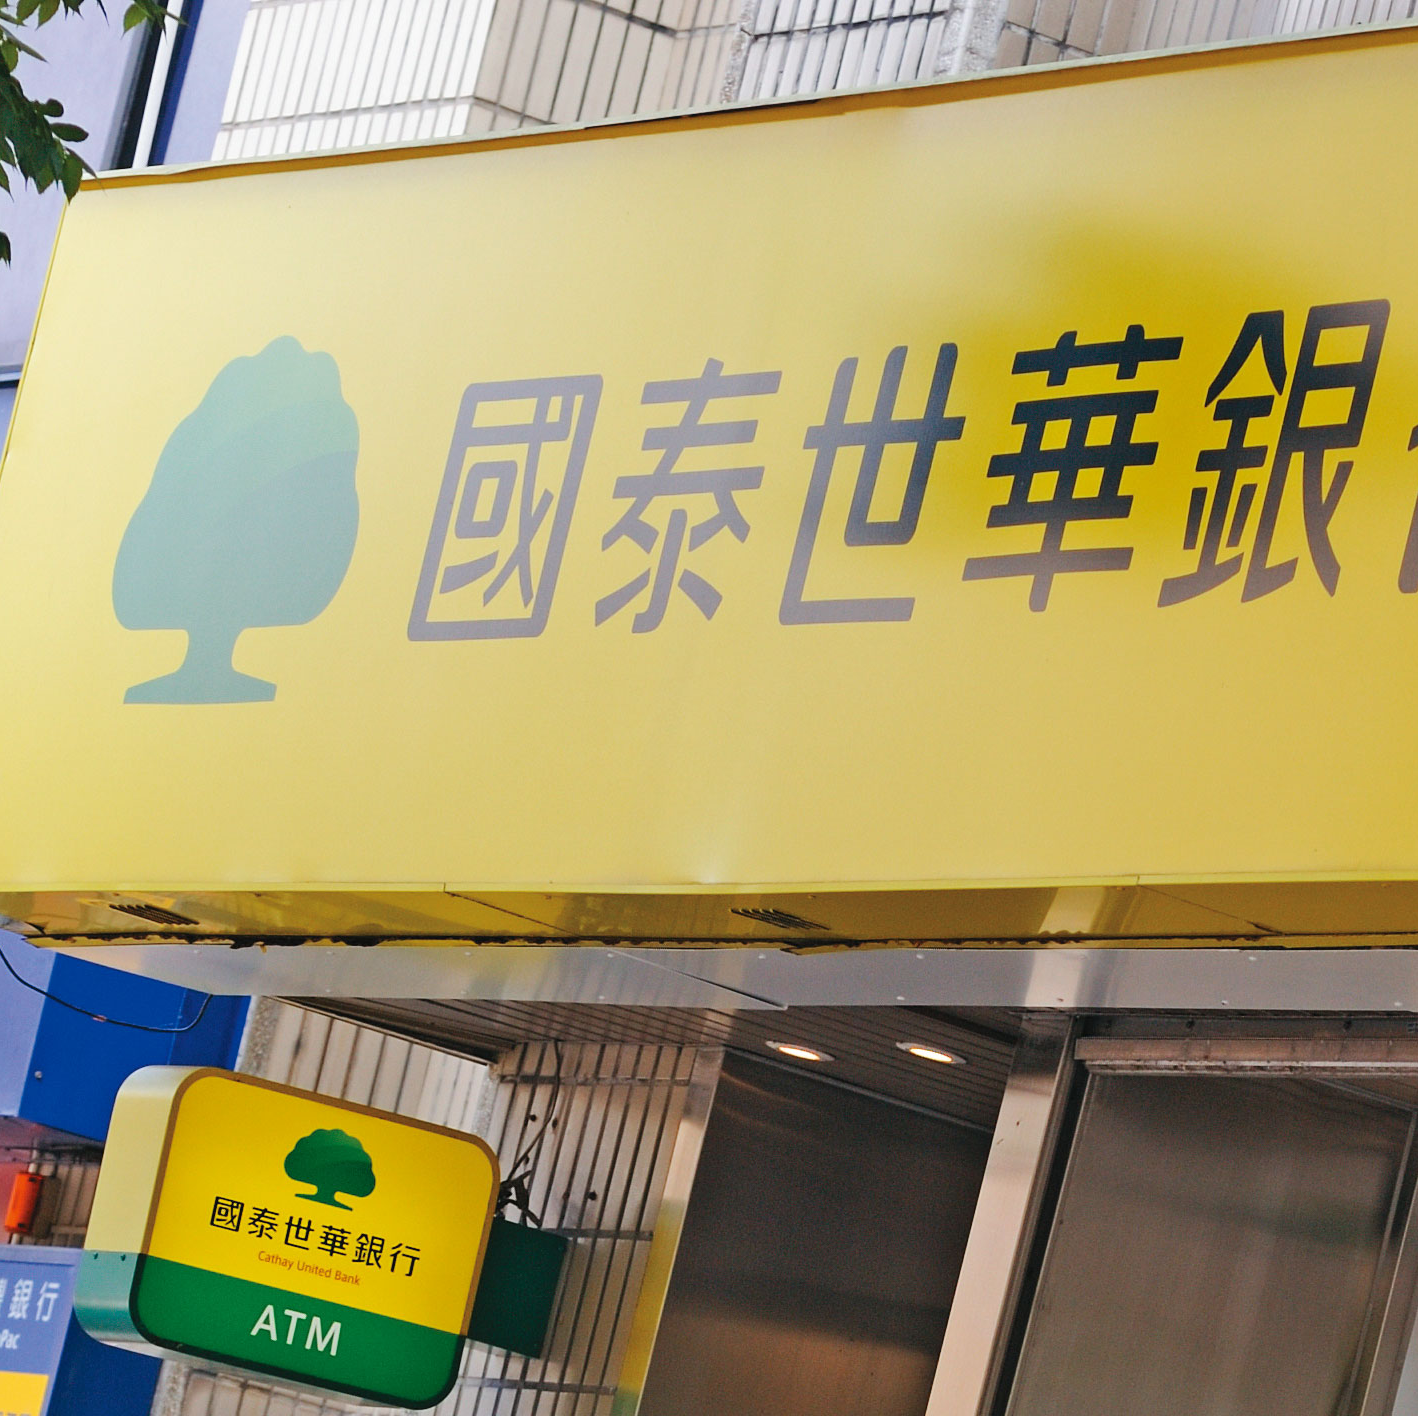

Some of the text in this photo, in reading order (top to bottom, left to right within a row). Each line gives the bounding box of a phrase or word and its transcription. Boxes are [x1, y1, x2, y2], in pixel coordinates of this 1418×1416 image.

[210, 1196, 421, 1277] 國泰世華銀行
[257, 1250, 361, 1286] Cathay United Bank
[250, 1304, 342, 1357] ATM
